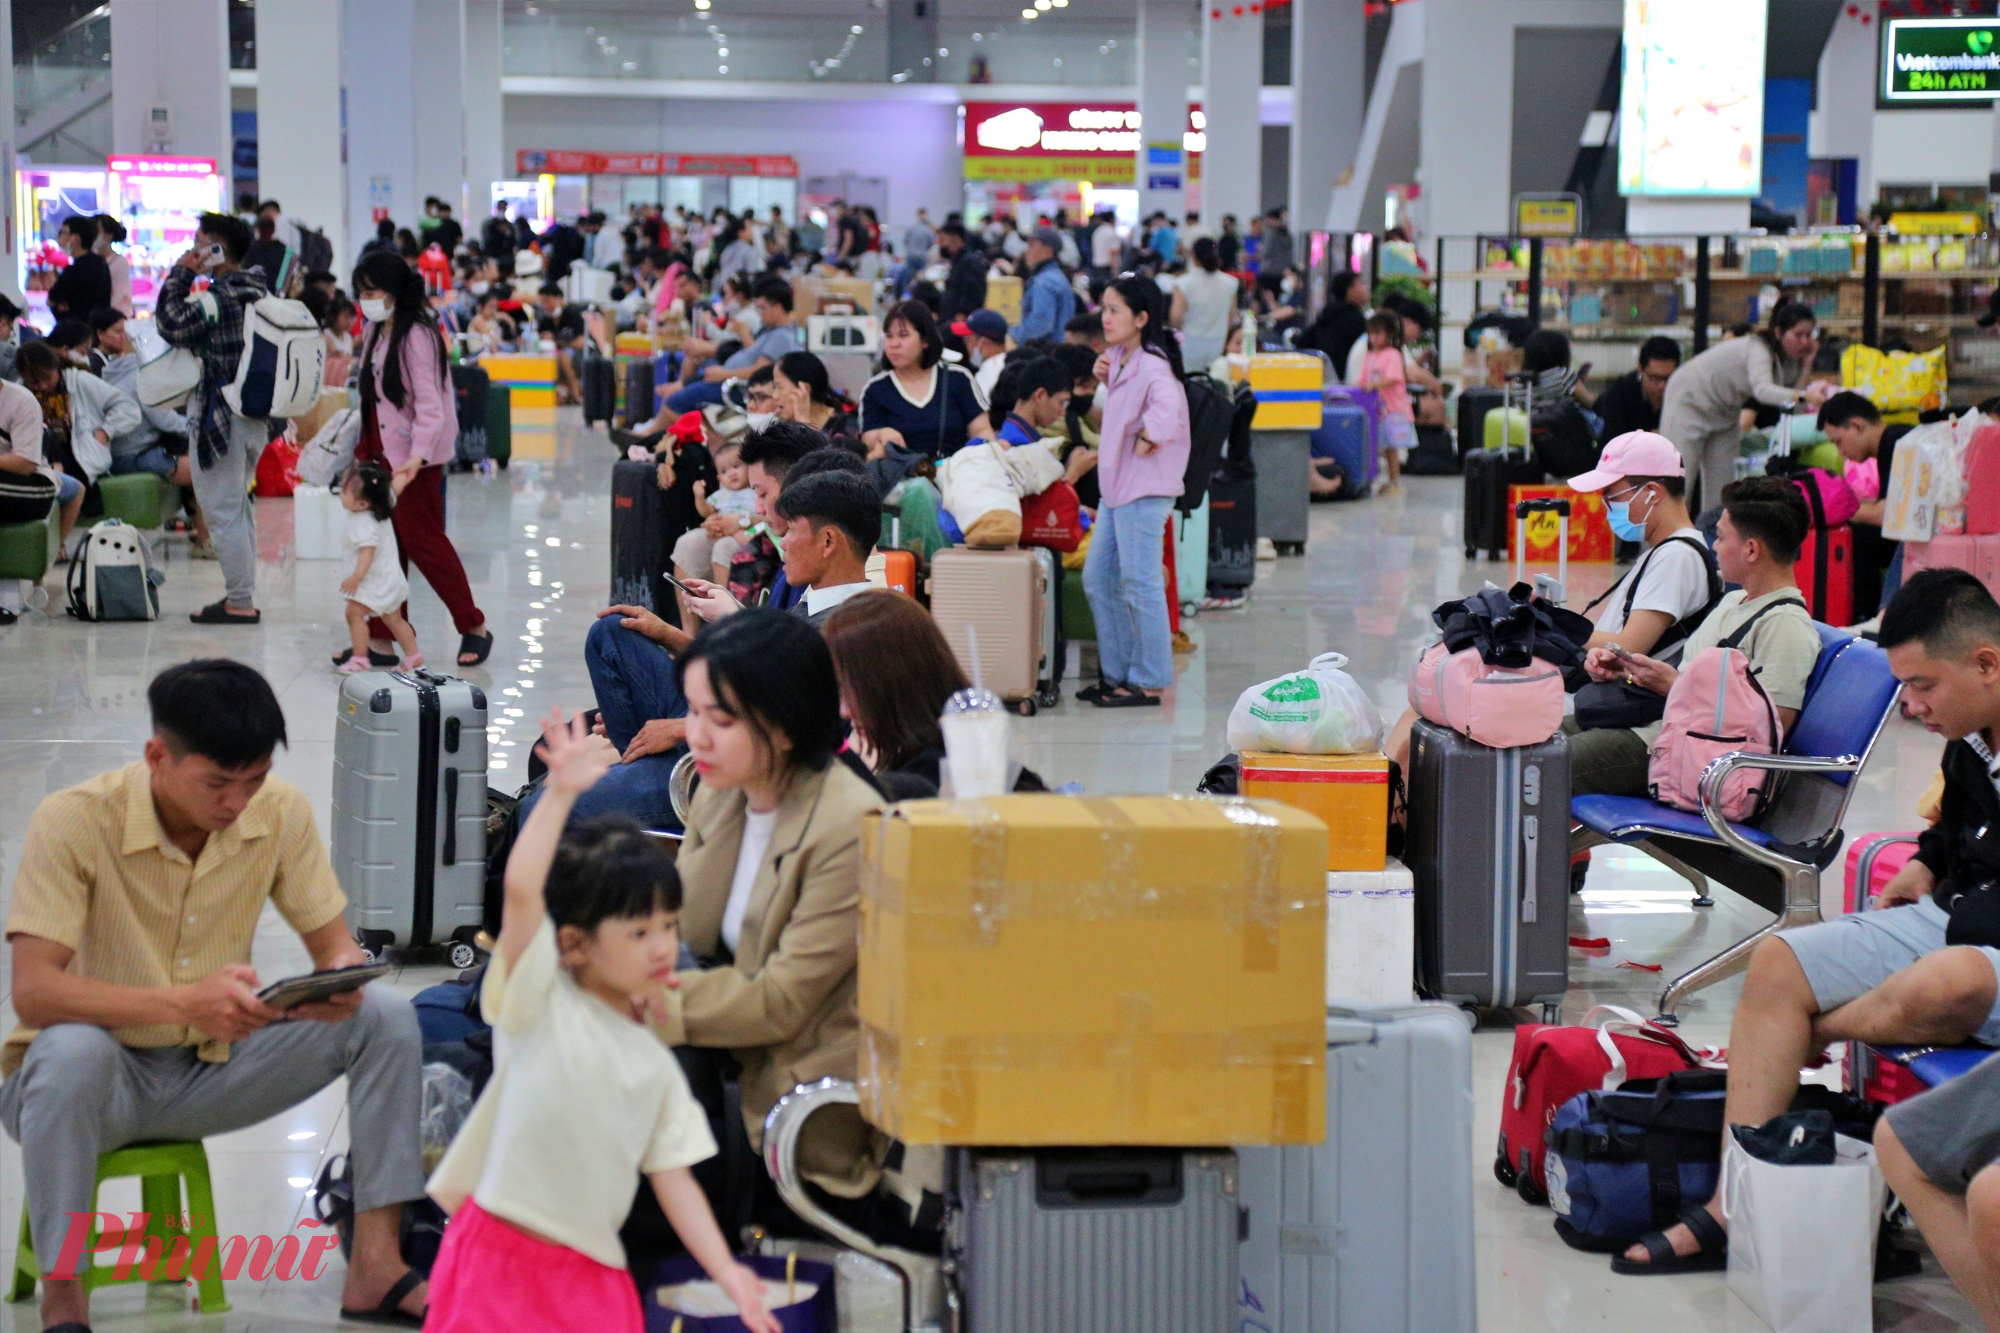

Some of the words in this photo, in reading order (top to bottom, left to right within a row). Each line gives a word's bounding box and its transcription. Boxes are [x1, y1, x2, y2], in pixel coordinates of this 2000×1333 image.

[1896, 51, 2000, 71] Vietcombank
[1909, 72, 1946, 90] 24h
[1948, 72, 1986, 89] ATM
